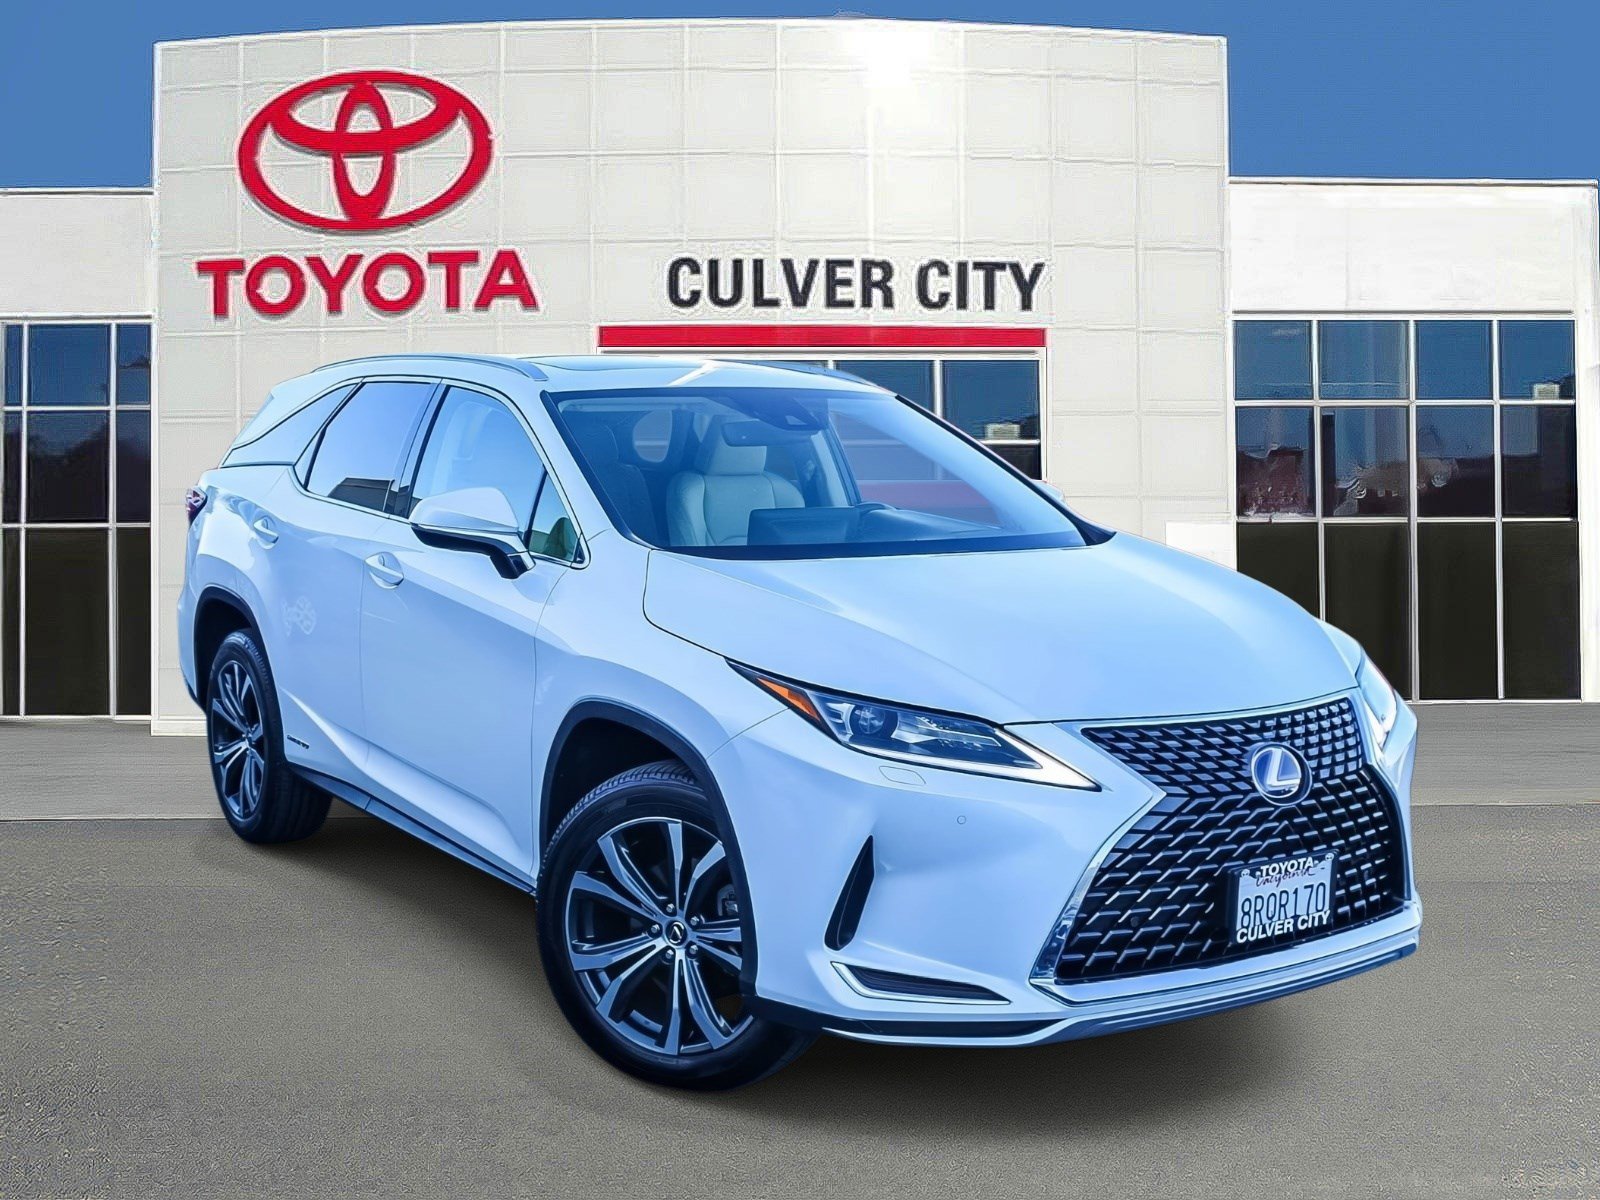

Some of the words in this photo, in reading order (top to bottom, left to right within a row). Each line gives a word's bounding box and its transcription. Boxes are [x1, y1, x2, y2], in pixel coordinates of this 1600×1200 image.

[195, 249, 539, 318] TOYOTA
[667, 256, 895, 309] CULVER
[916, 259, 1046, 311] CITY
[1260, 856, 1314, 877] TOYOTA
[1236, 918, 1294, 944] CULVER
[1297, 910, 1331, 931] CITY
